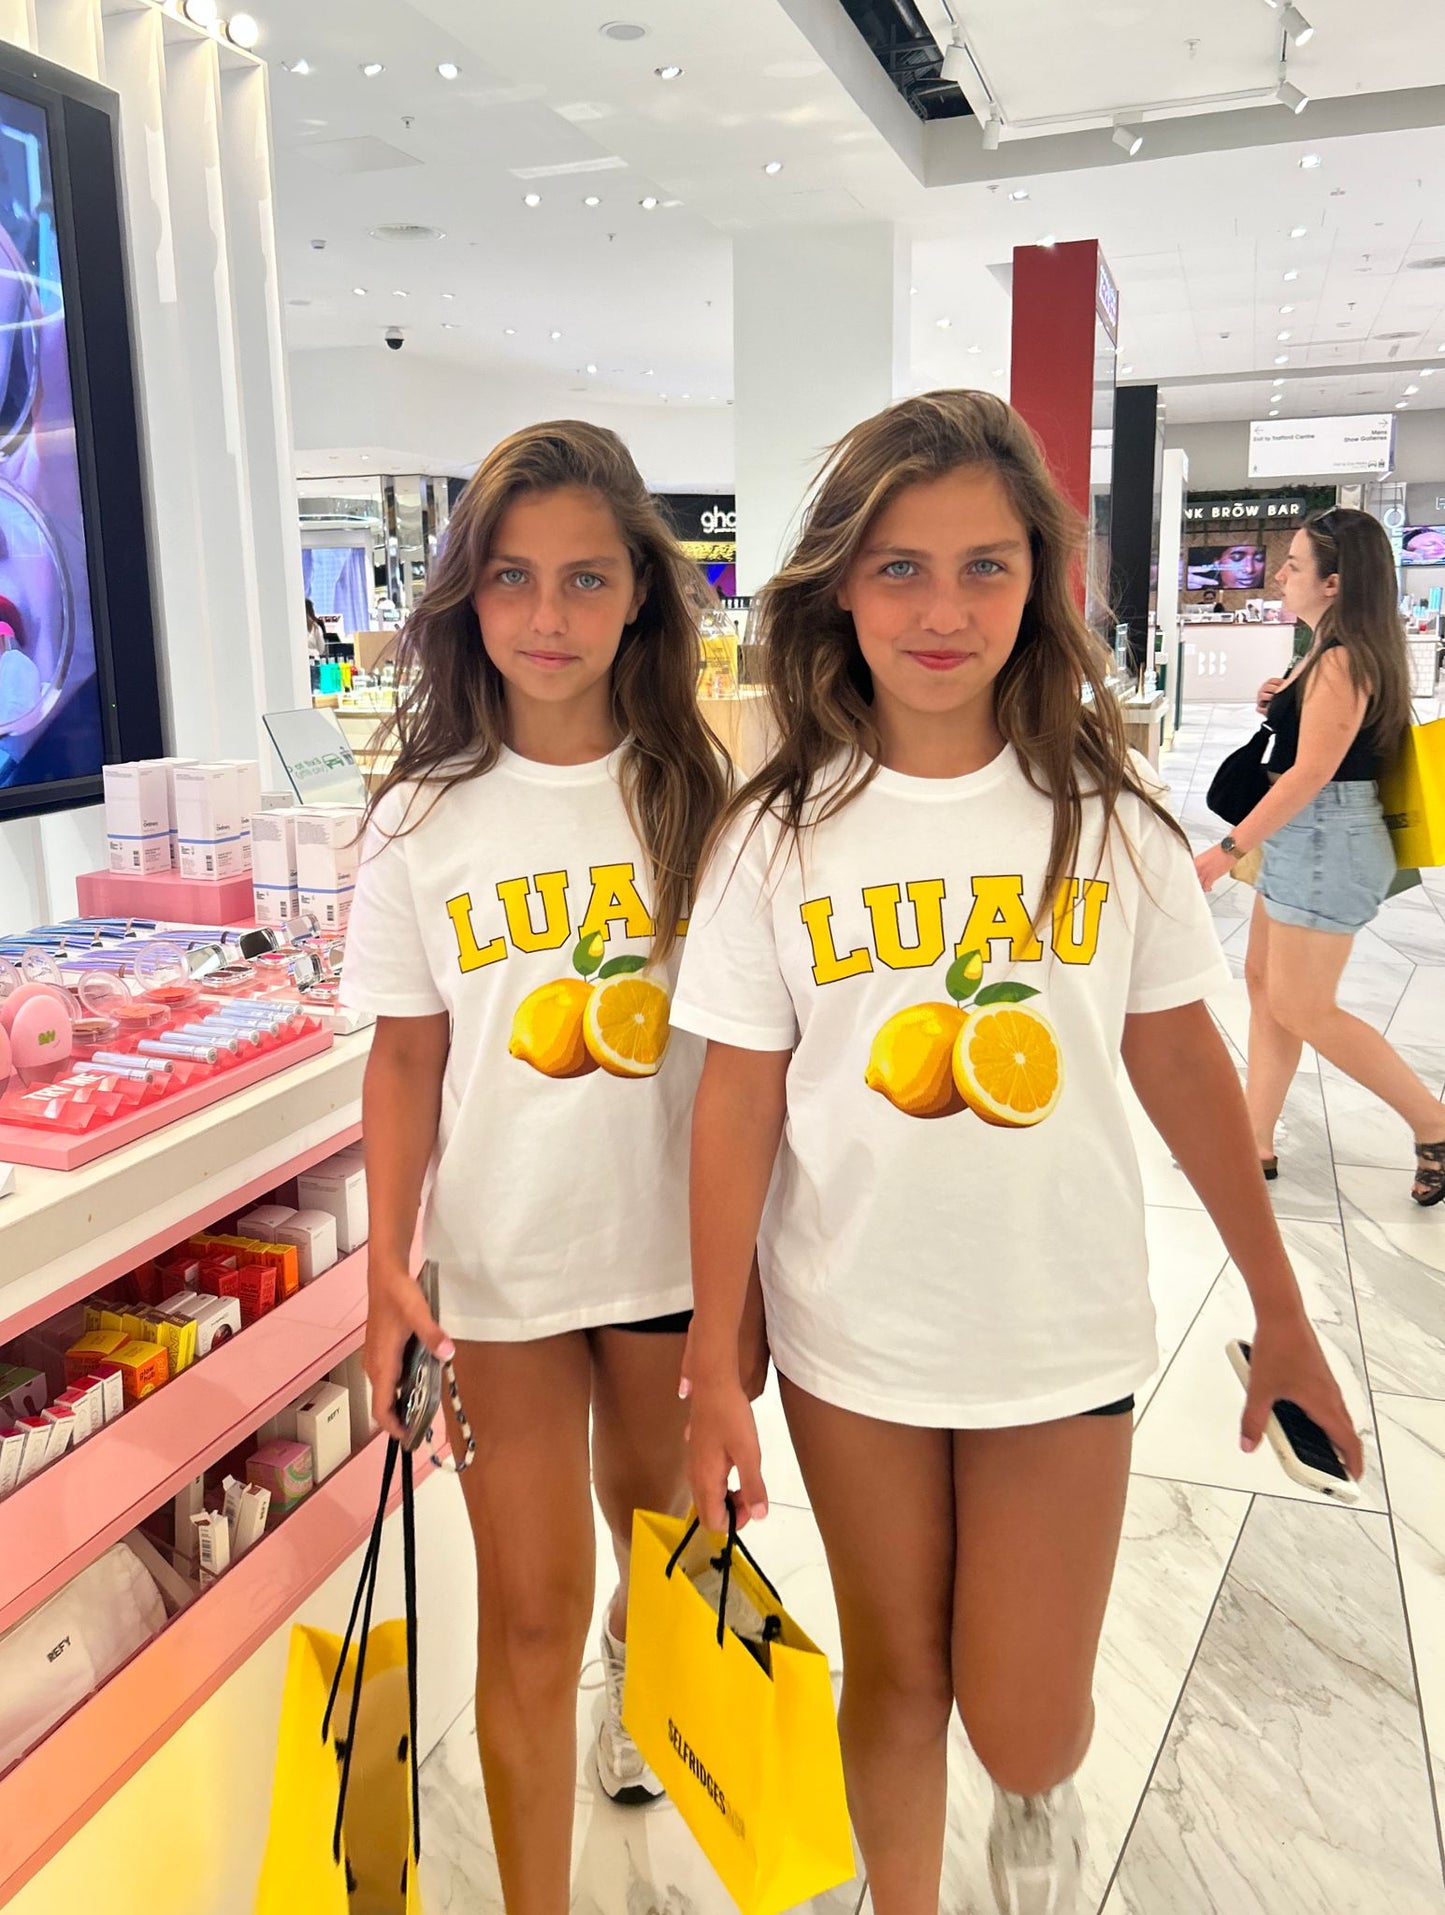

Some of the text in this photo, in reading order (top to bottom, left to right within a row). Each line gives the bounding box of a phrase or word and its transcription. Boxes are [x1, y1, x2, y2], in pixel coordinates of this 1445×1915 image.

[1267, 503, 1300, 517] BAR
[799, 874, 1110, 987] LUAU
[20, 1072, 107, 1102] TRY ME
[326, 1405, 341, 1424] REFY
[46, 1635, 72, 1663] REFY
